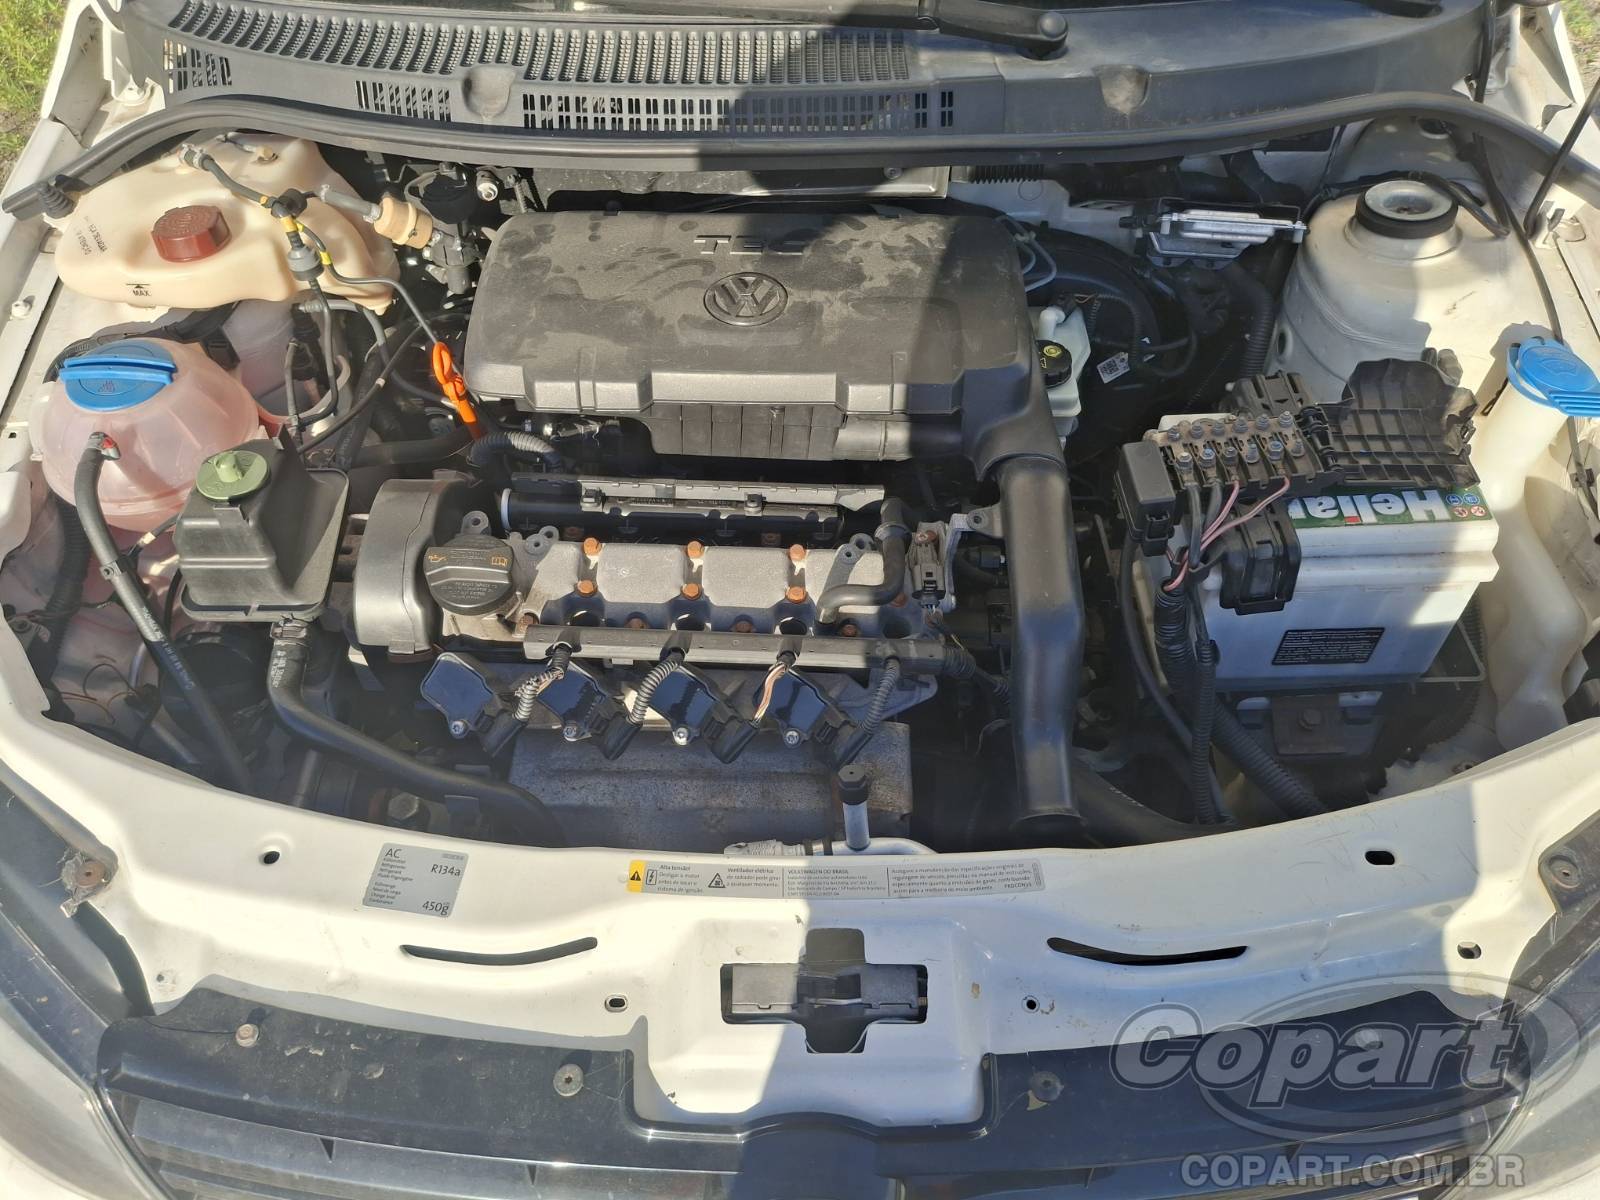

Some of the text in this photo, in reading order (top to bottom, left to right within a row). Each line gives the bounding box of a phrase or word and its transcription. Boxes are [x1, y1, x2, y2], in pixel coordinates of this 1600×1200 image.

[384, 848, 402, 859] AC
[430, 863, 461, 877] R134a
[422, 900, 450, 916] 450g
